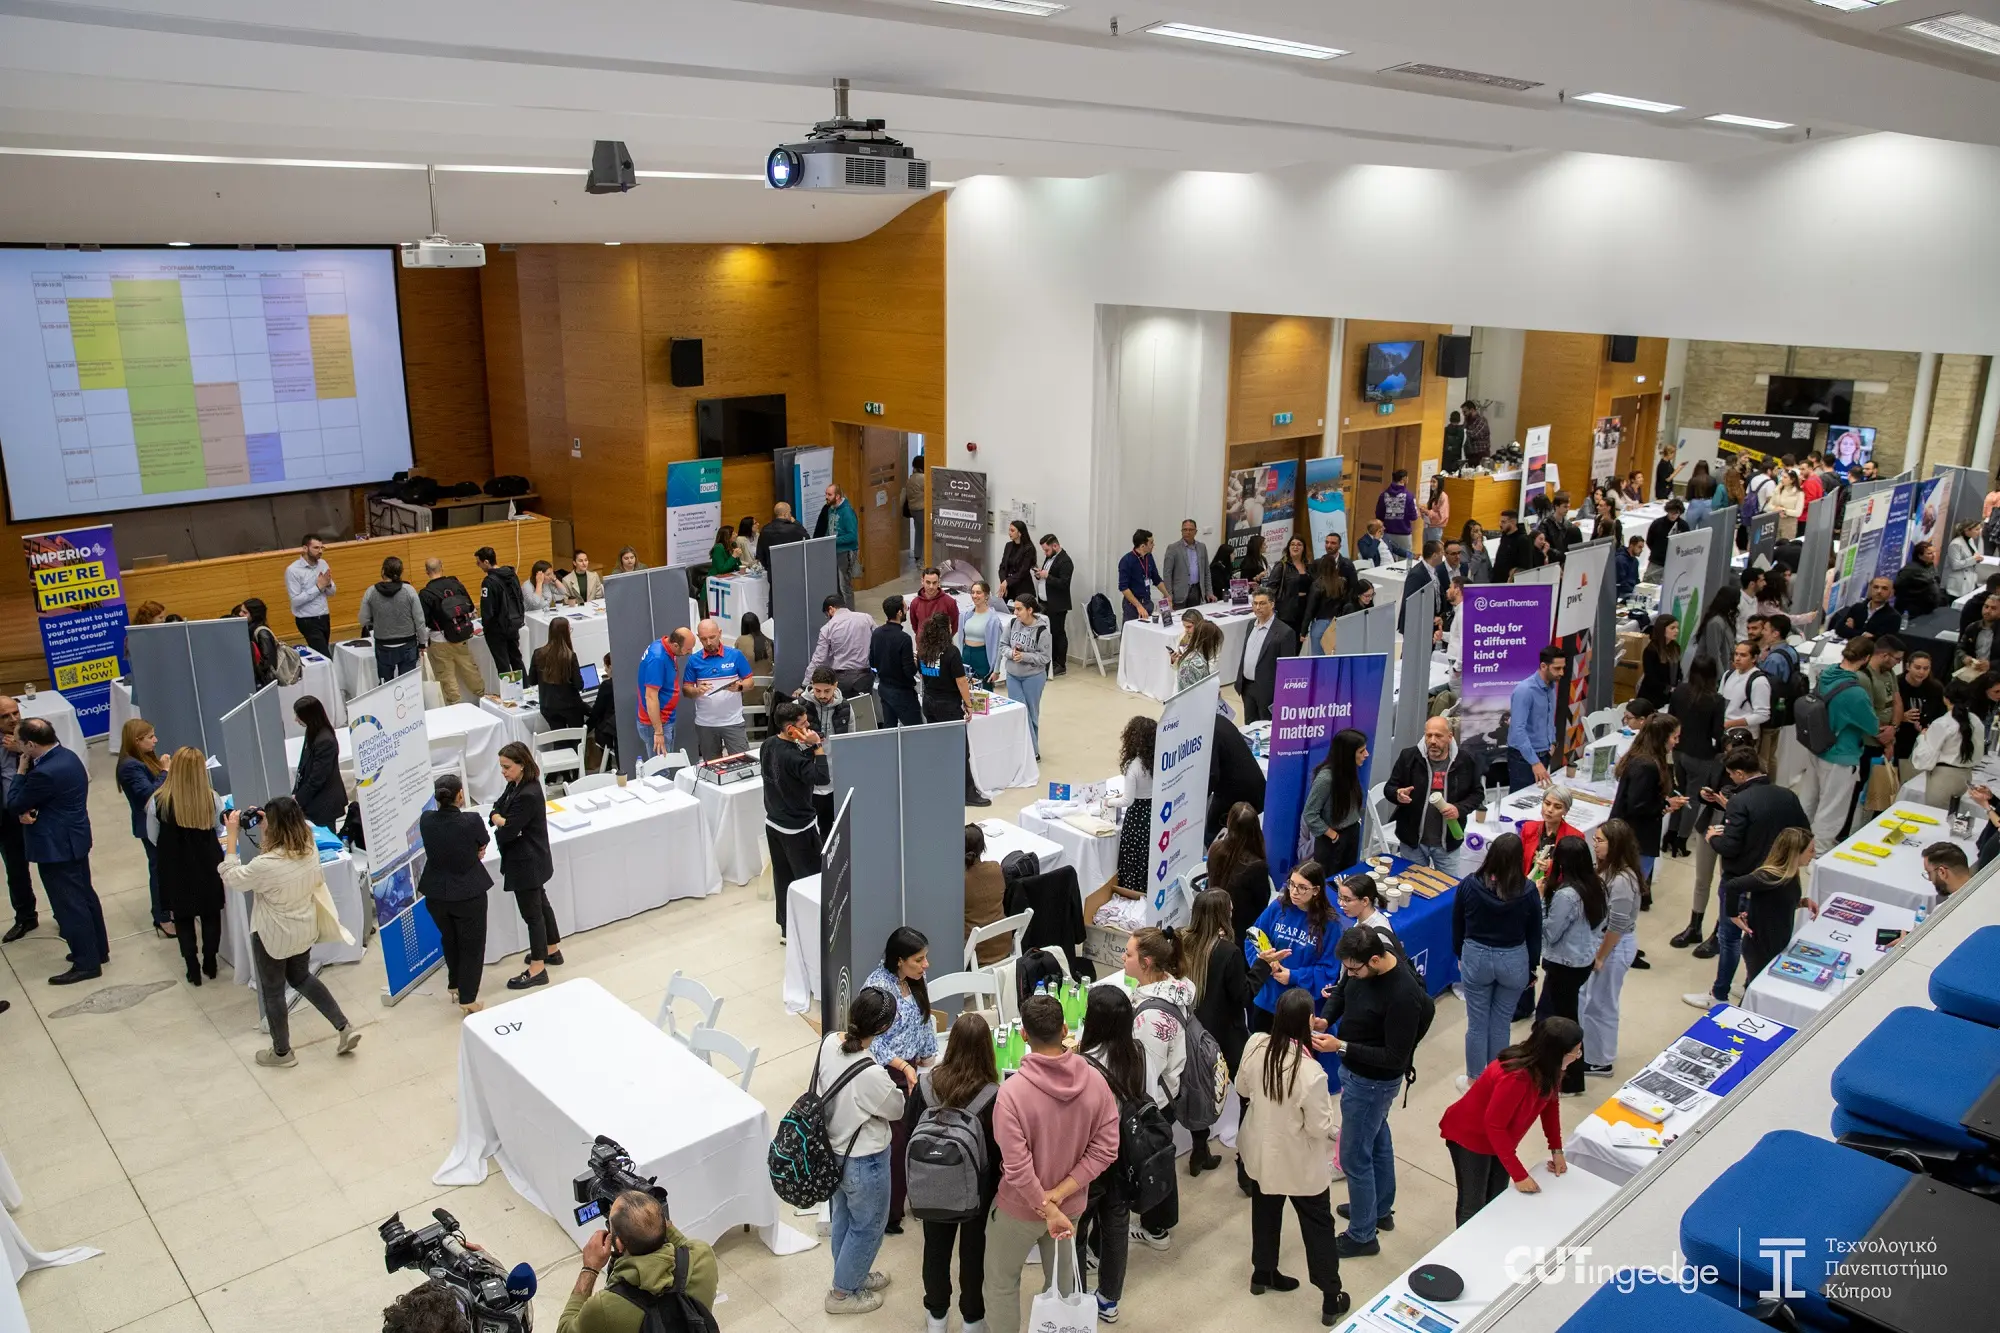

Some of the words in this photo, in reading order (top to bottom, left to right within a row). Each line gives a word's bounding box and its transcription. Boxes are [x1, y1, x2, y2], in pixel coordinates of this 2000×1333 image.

[941, 519, 983, 530] HOSPITALITY
[30, 546, 91, 565] IMPERIO
[45, 584, 116, 606] HIRING!
[1566, 593, 1583, 608] pwc
[58, 620, 73, 629] you
[104, 610, 123, 618] build
[48, 630, 64, 639] your
[66, 624, 90, 634] career
[92, 621, 109, 630] path
[1474, 624, 1506, 634] Ready
[1508, 623, 1523, 632] for
[49, 636, 78, 646] Imperio
[80, 630, 107, 640] Group?
[1483, 636, 1526, 646] different
[1474, 651, 1495, 660] kind
[1497, 650, 1508, 659] of
[80, 660, 114, 673] APPLY
[1473, 663, 1499, 673] firm?
[82, 669, 113, 682] NOW!
[1281, 706, 1296, 720] Do
[1298, 704, 1326, 720] work
[1328, 702, 1352, 717] that
[1163, 720, 1180, 732] KPMG
[1279, 724, 1324, 740] matters
[1162, 750, 1177, 771] Our
[1178, 735, 1202, 762] Values
[362, 763, 377, 775] ΚΑΘΕ
[1275, 923, 1298, 936] DEAR
[494, 1021, 522, 1035] 40
[1737, 1017, 1765, 1034] 20
